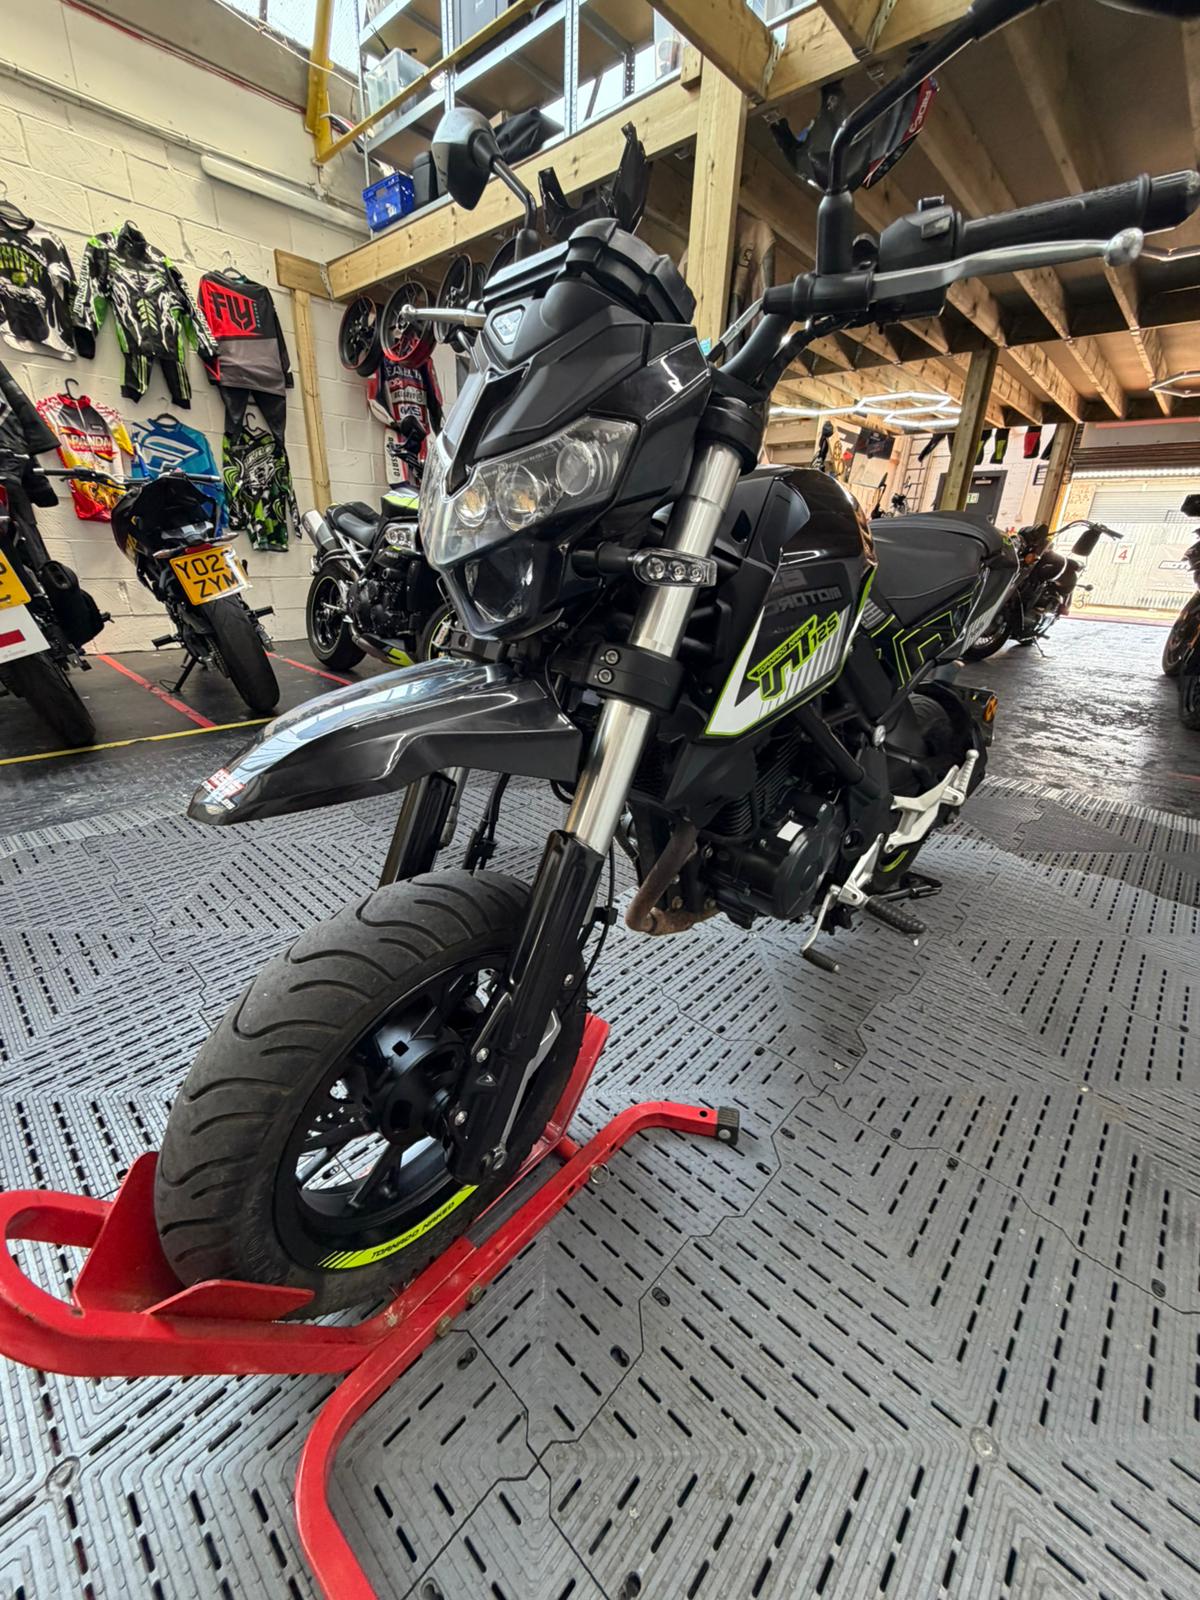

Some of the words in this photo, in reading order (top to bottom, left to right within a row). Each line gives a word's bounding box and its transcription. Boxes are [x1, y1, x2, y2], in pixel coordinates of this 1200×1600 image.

[211, 291, 255, 331] FLY
[1118, 549, 1128, 561] 4
[371, 1229, 420, 1259] TORNADO
[421, 1201, 455, 1232] NAKED
